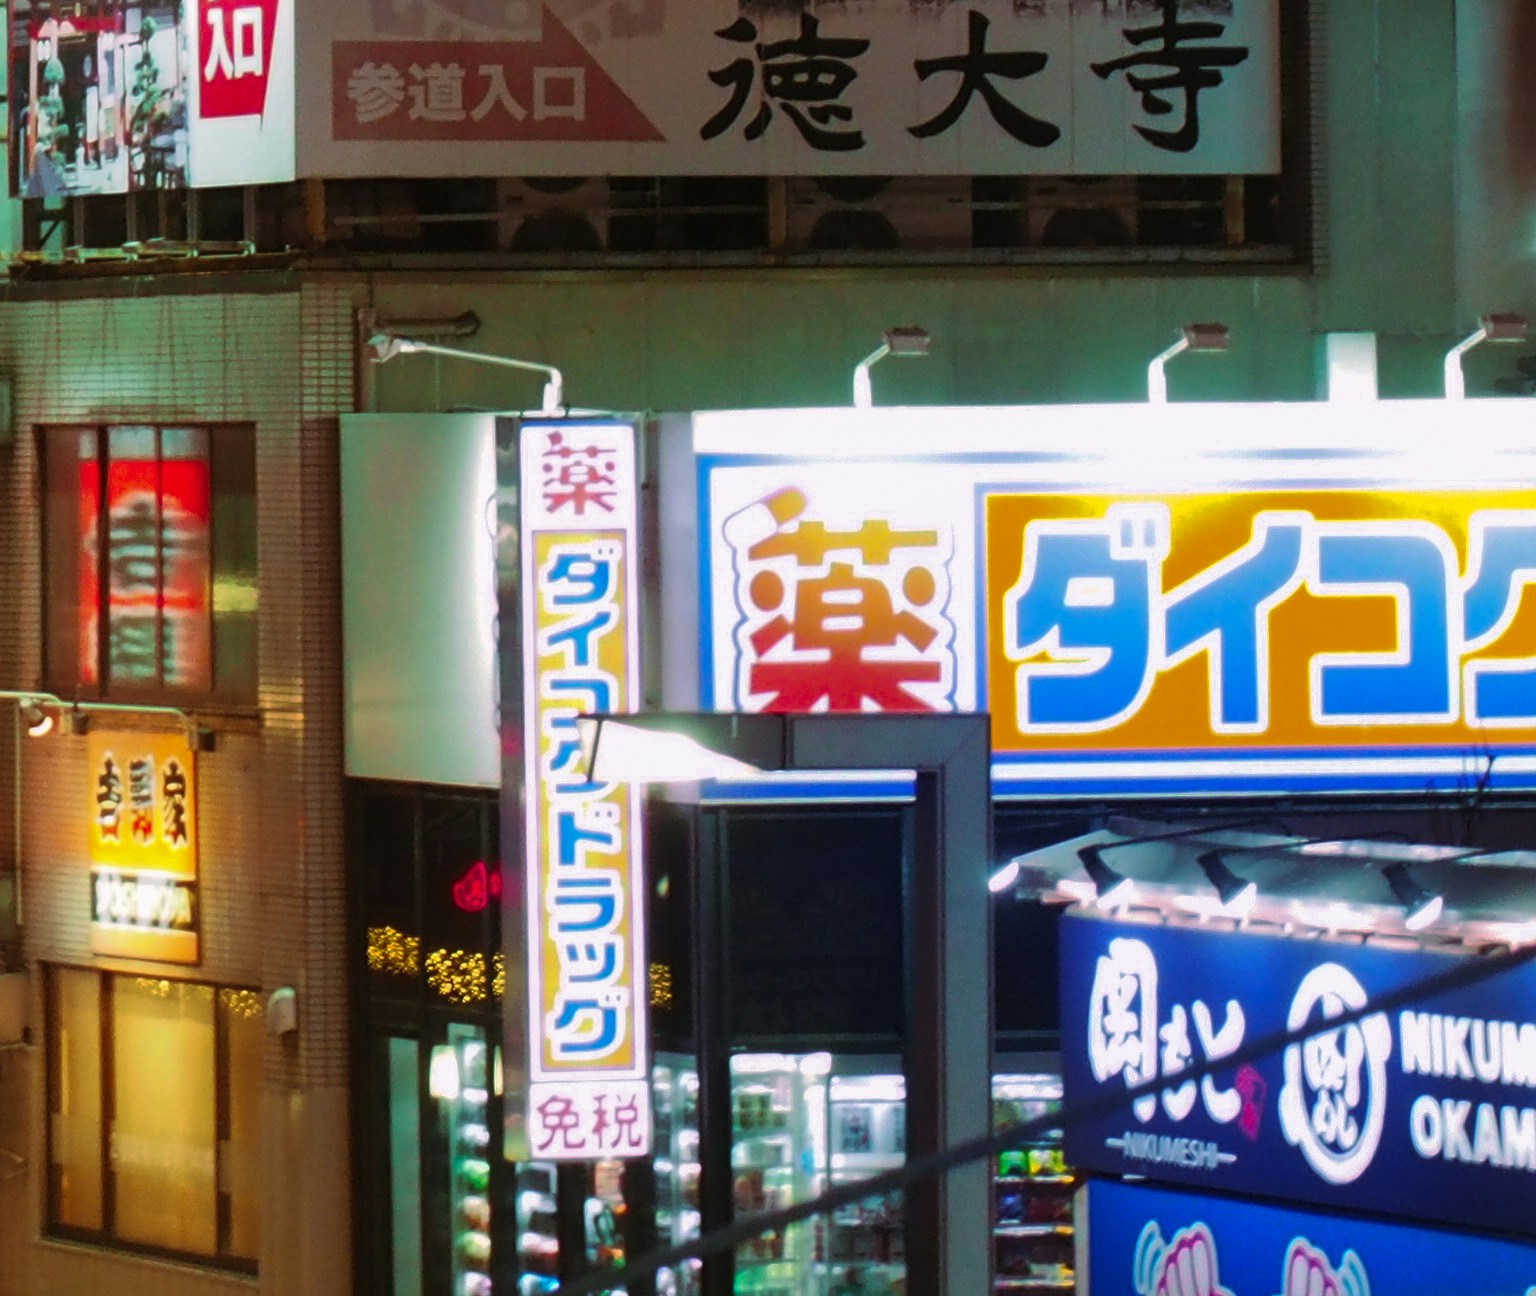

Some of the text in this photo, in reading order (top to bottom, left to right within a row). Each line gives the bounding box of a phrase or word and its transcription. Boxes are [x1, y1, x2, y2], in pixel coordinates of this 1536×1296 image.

[346, 59, 588, 123] 参道入口
[541, 431, 616, 516] 薬
[728, 487, 941, 712] 薬
[536, 1092, 643, 1151] 免税
